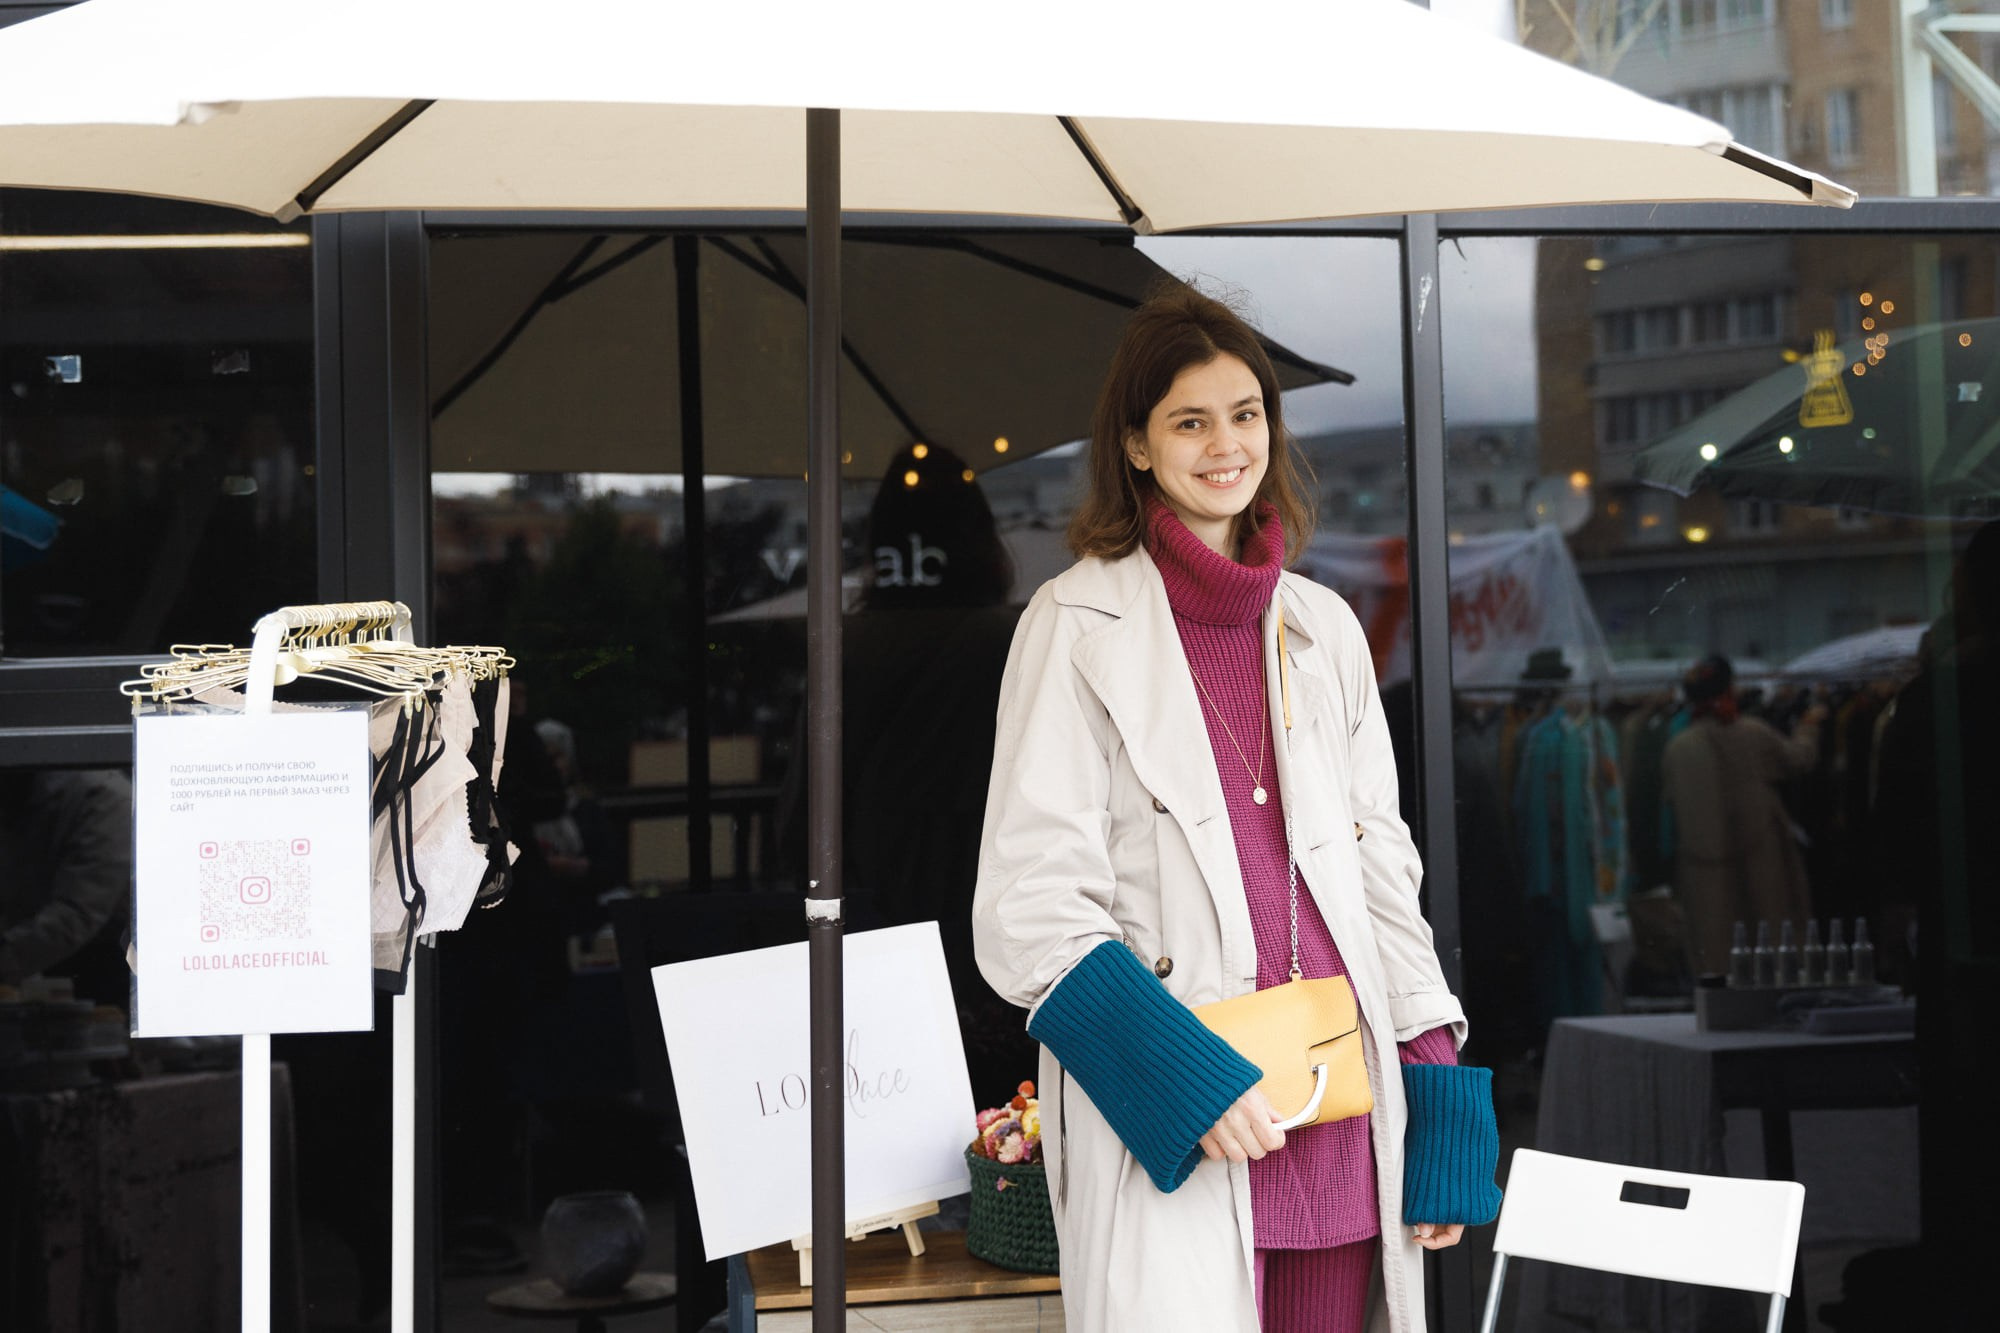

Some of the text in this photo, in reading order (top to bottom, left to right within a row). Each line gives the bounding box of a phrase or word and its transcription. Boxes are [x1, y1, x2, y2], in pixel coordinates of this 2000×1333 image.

[170, 760, 316, 774] ПОДПИШИСЬ И ПОЛУЧИ СВОЮ
[170, 772, 349, 787] ВДОХНОВЛЯЮЩУЮ АФФИРМАЦИЮ И
[171, 785, 350, 799] 1000 РУБЛЕЙ НА ПЕРВЫЙ ЗАКАЗ ЧЕРЕЗ
[170, 801, 195, 812] САЙТ
[183, 950, 329, 971] LOLOLACEOFFICIAL
